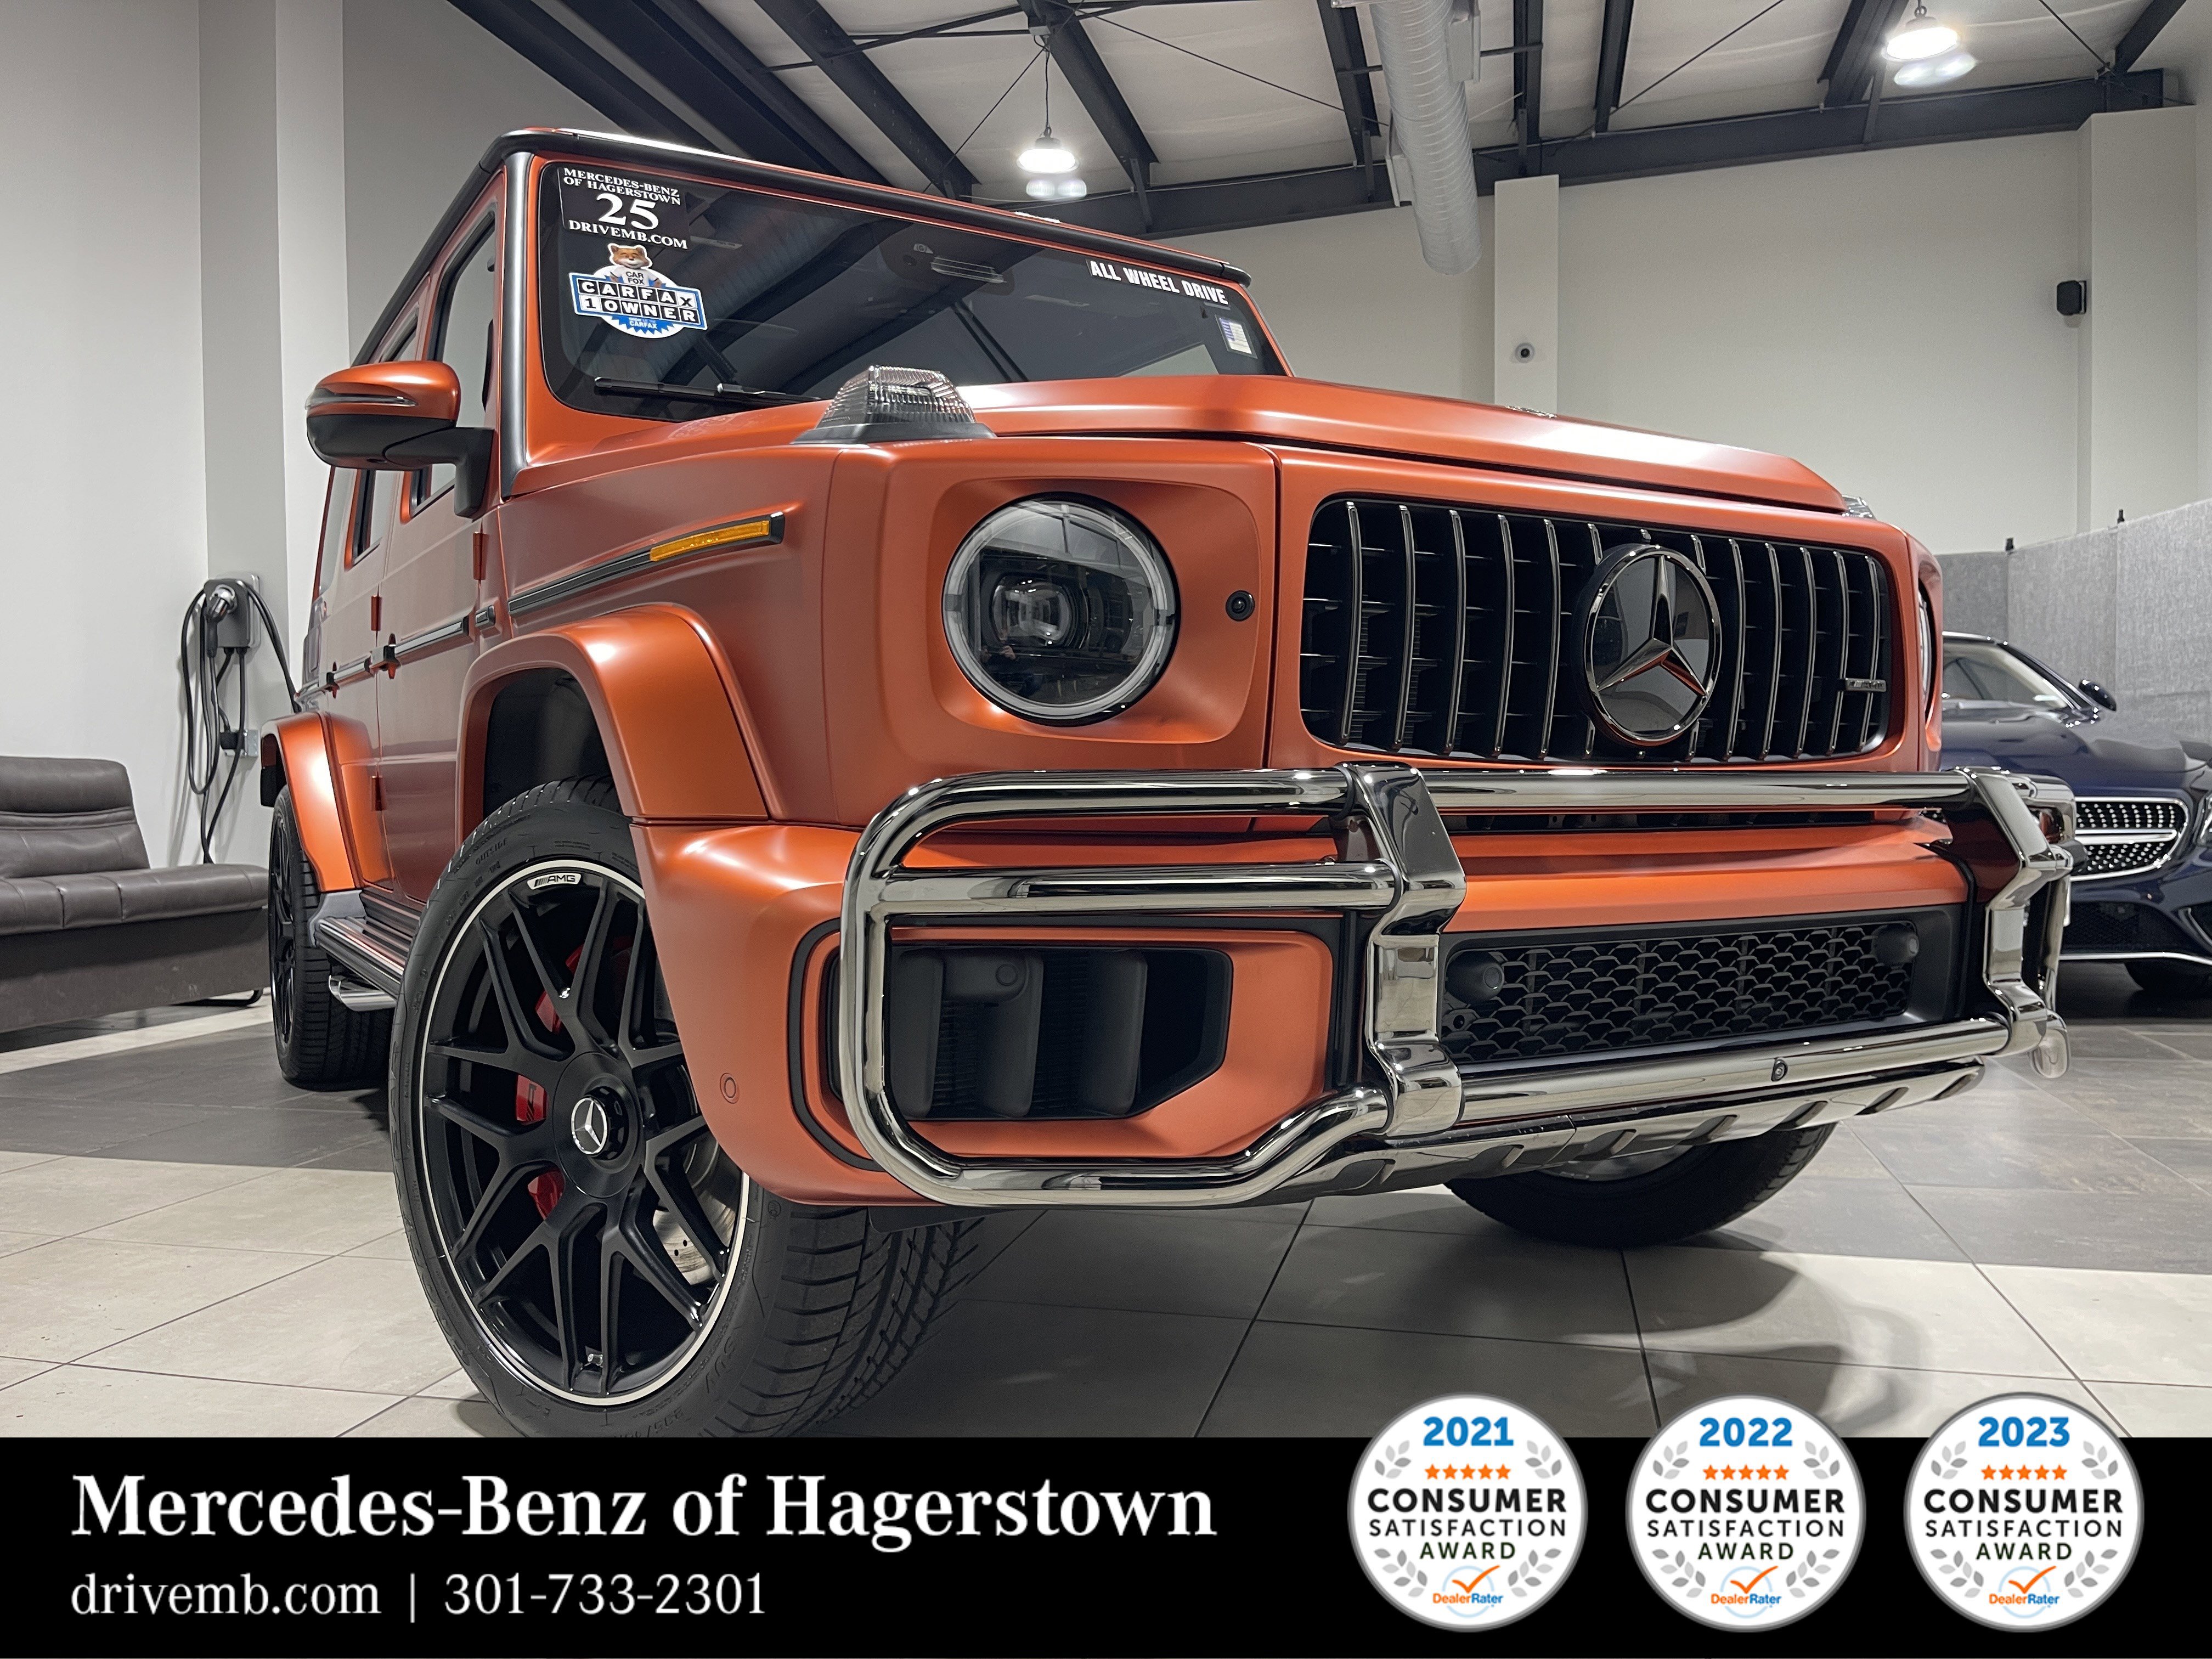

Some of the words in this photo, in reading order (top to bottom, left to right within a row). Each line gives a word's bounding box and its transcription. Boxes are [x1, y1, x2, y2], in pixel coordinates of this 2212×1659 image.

[563, 177, 583, 187] OF
[588, 180, 681, 206] HAGERSTOWN
[564, 167, 680, 198] MERCEDES-BENZ
[596, 193, 659, 230] 25
[568, 220, 689, 250] DRIVEMB.COM
[625, 270, 644, 279] CAR
[1090, 260, 1121, 281] ALL
[1123, 267, 1180, 294] WHEEL
[1182, 279, 1229, 305] DRIVE
[582, 281, 693, 308] CARFAX
[629, 320, 658, 329] CARFAX
